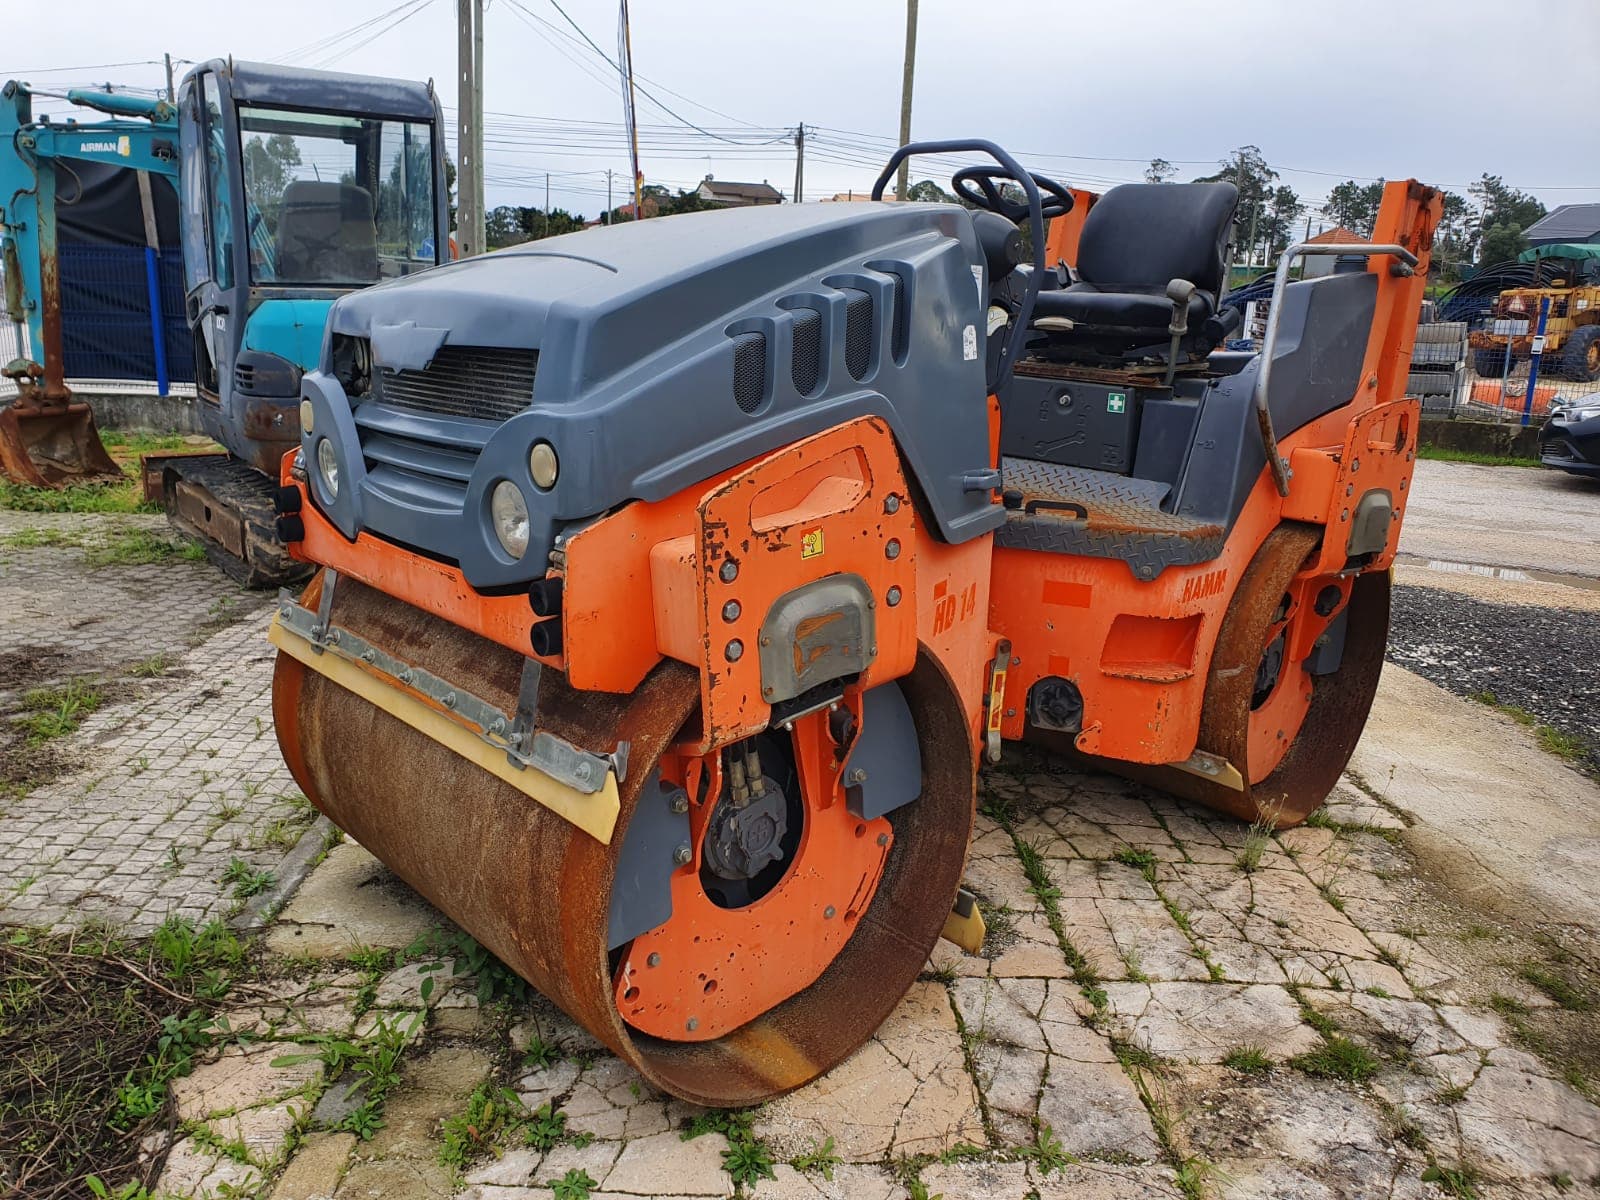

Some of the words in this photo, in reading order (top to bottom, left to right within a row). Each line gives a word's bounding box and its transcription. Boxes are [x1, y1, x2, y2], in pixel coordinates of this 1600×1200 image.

[80, 142, 117, 153] AIRMAN
[1182, 568, 1228, 604] HAMM
[933, 594, 956, 637] HD
[960, 582, 977, 622] 14
